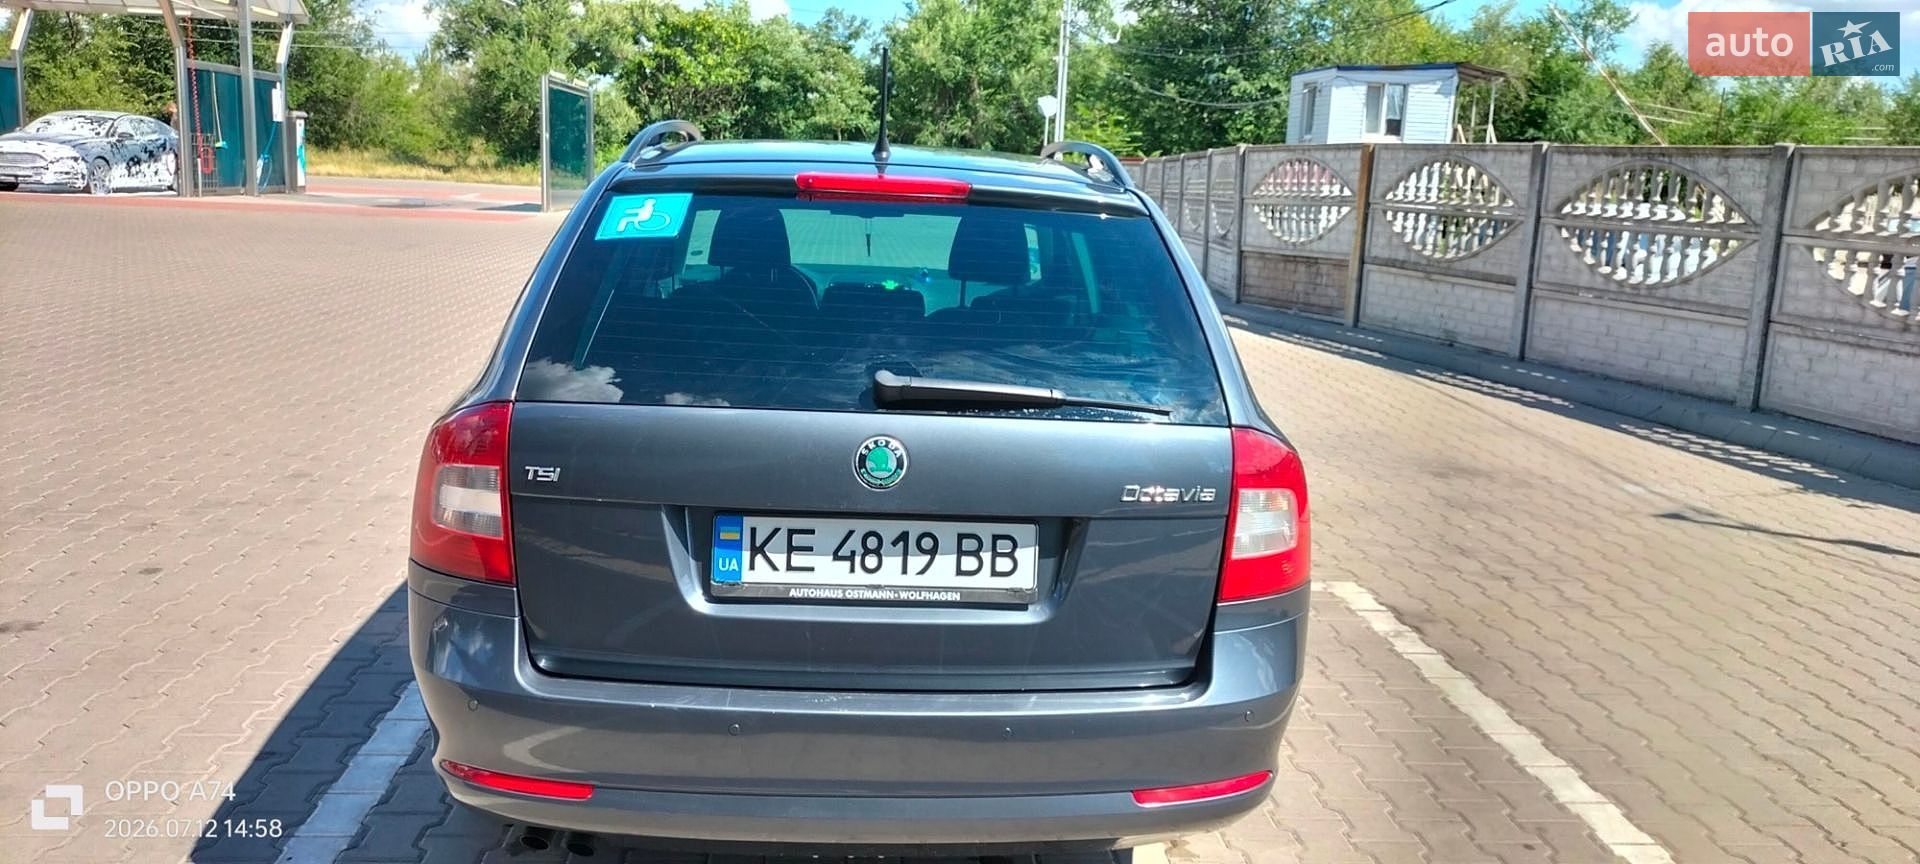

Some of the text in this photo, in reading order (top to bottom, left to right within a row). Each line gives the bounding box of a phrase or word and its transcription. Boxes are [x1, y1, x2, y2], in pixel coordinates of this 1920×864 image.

[525, 466, 560, 481] TSI
[1121, 485, 1217, 502] Octavia
[748, 527, 1019, 578] KE 4819 BB
[718, 557, 740, 572] UA
[789, 588, 843, 598] AUTOHAUS
